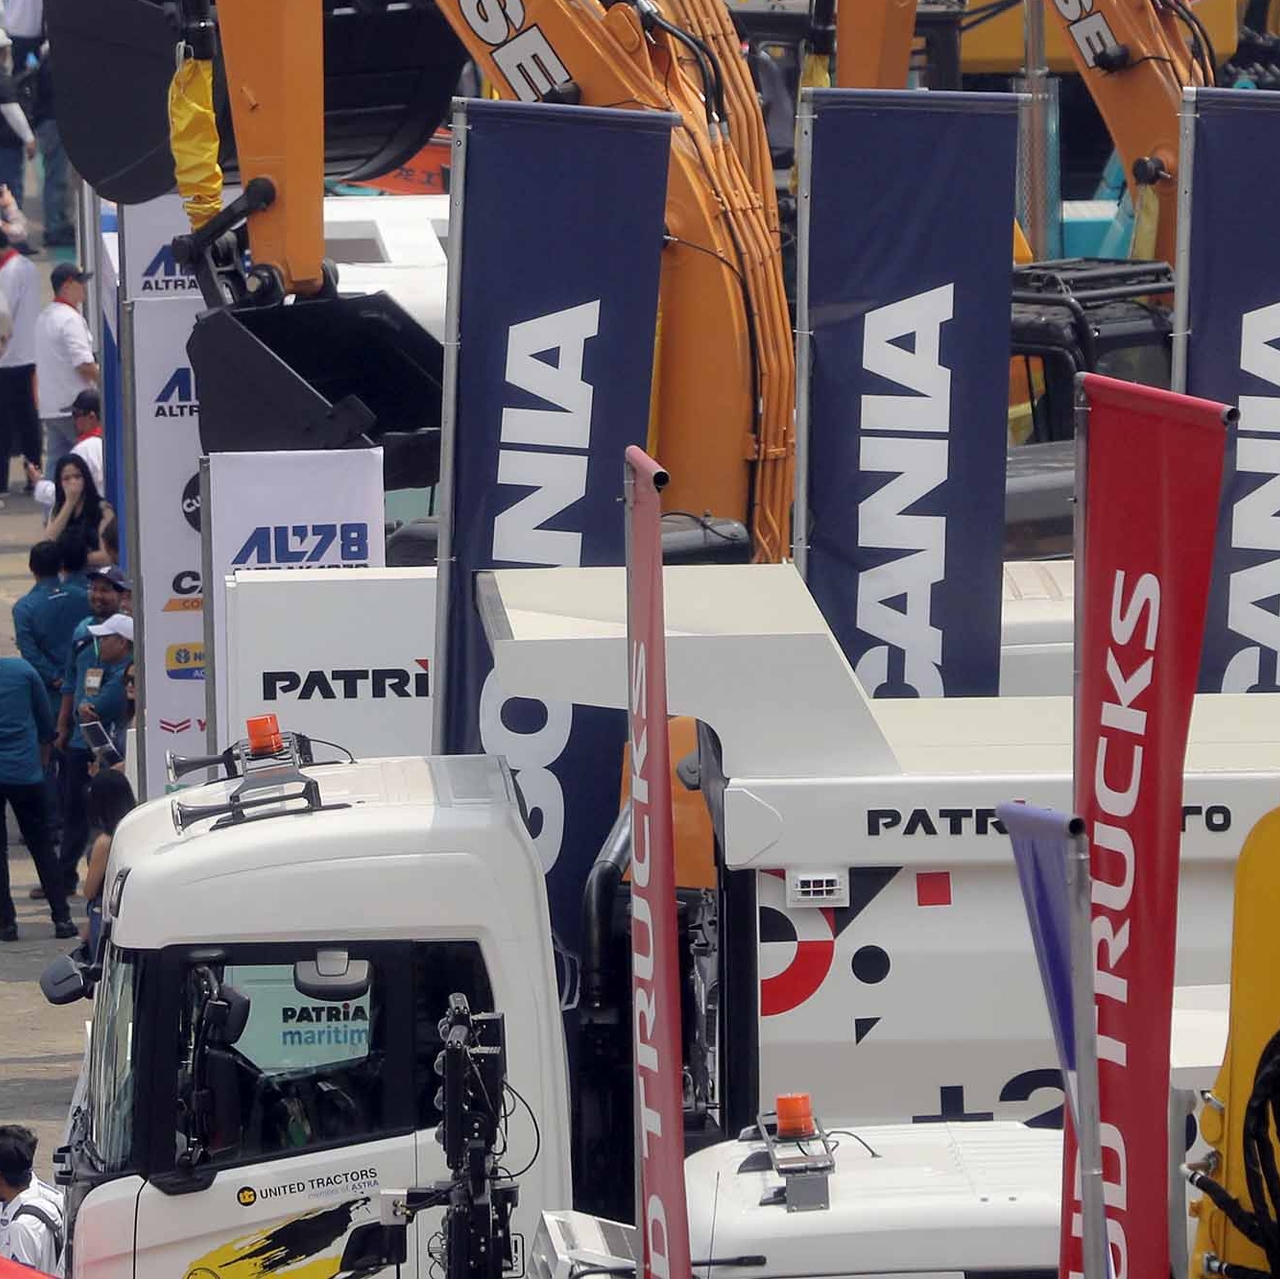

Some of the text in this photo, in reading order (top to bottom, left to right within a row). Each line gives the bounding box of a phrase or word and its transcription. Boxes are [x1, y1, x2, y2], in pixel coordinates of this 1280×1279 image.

[141, 278, 200, 291] ALTRA
[856, 283, 955, 698] CANIA
[263, 659, 429, 701] PATRI
[1093, 569, 1161, 1068] TRUCKS
[260, 1168, 377, 1200] UNITED TRACTORS
[351, 1180, 379, 1192] ASTRA
